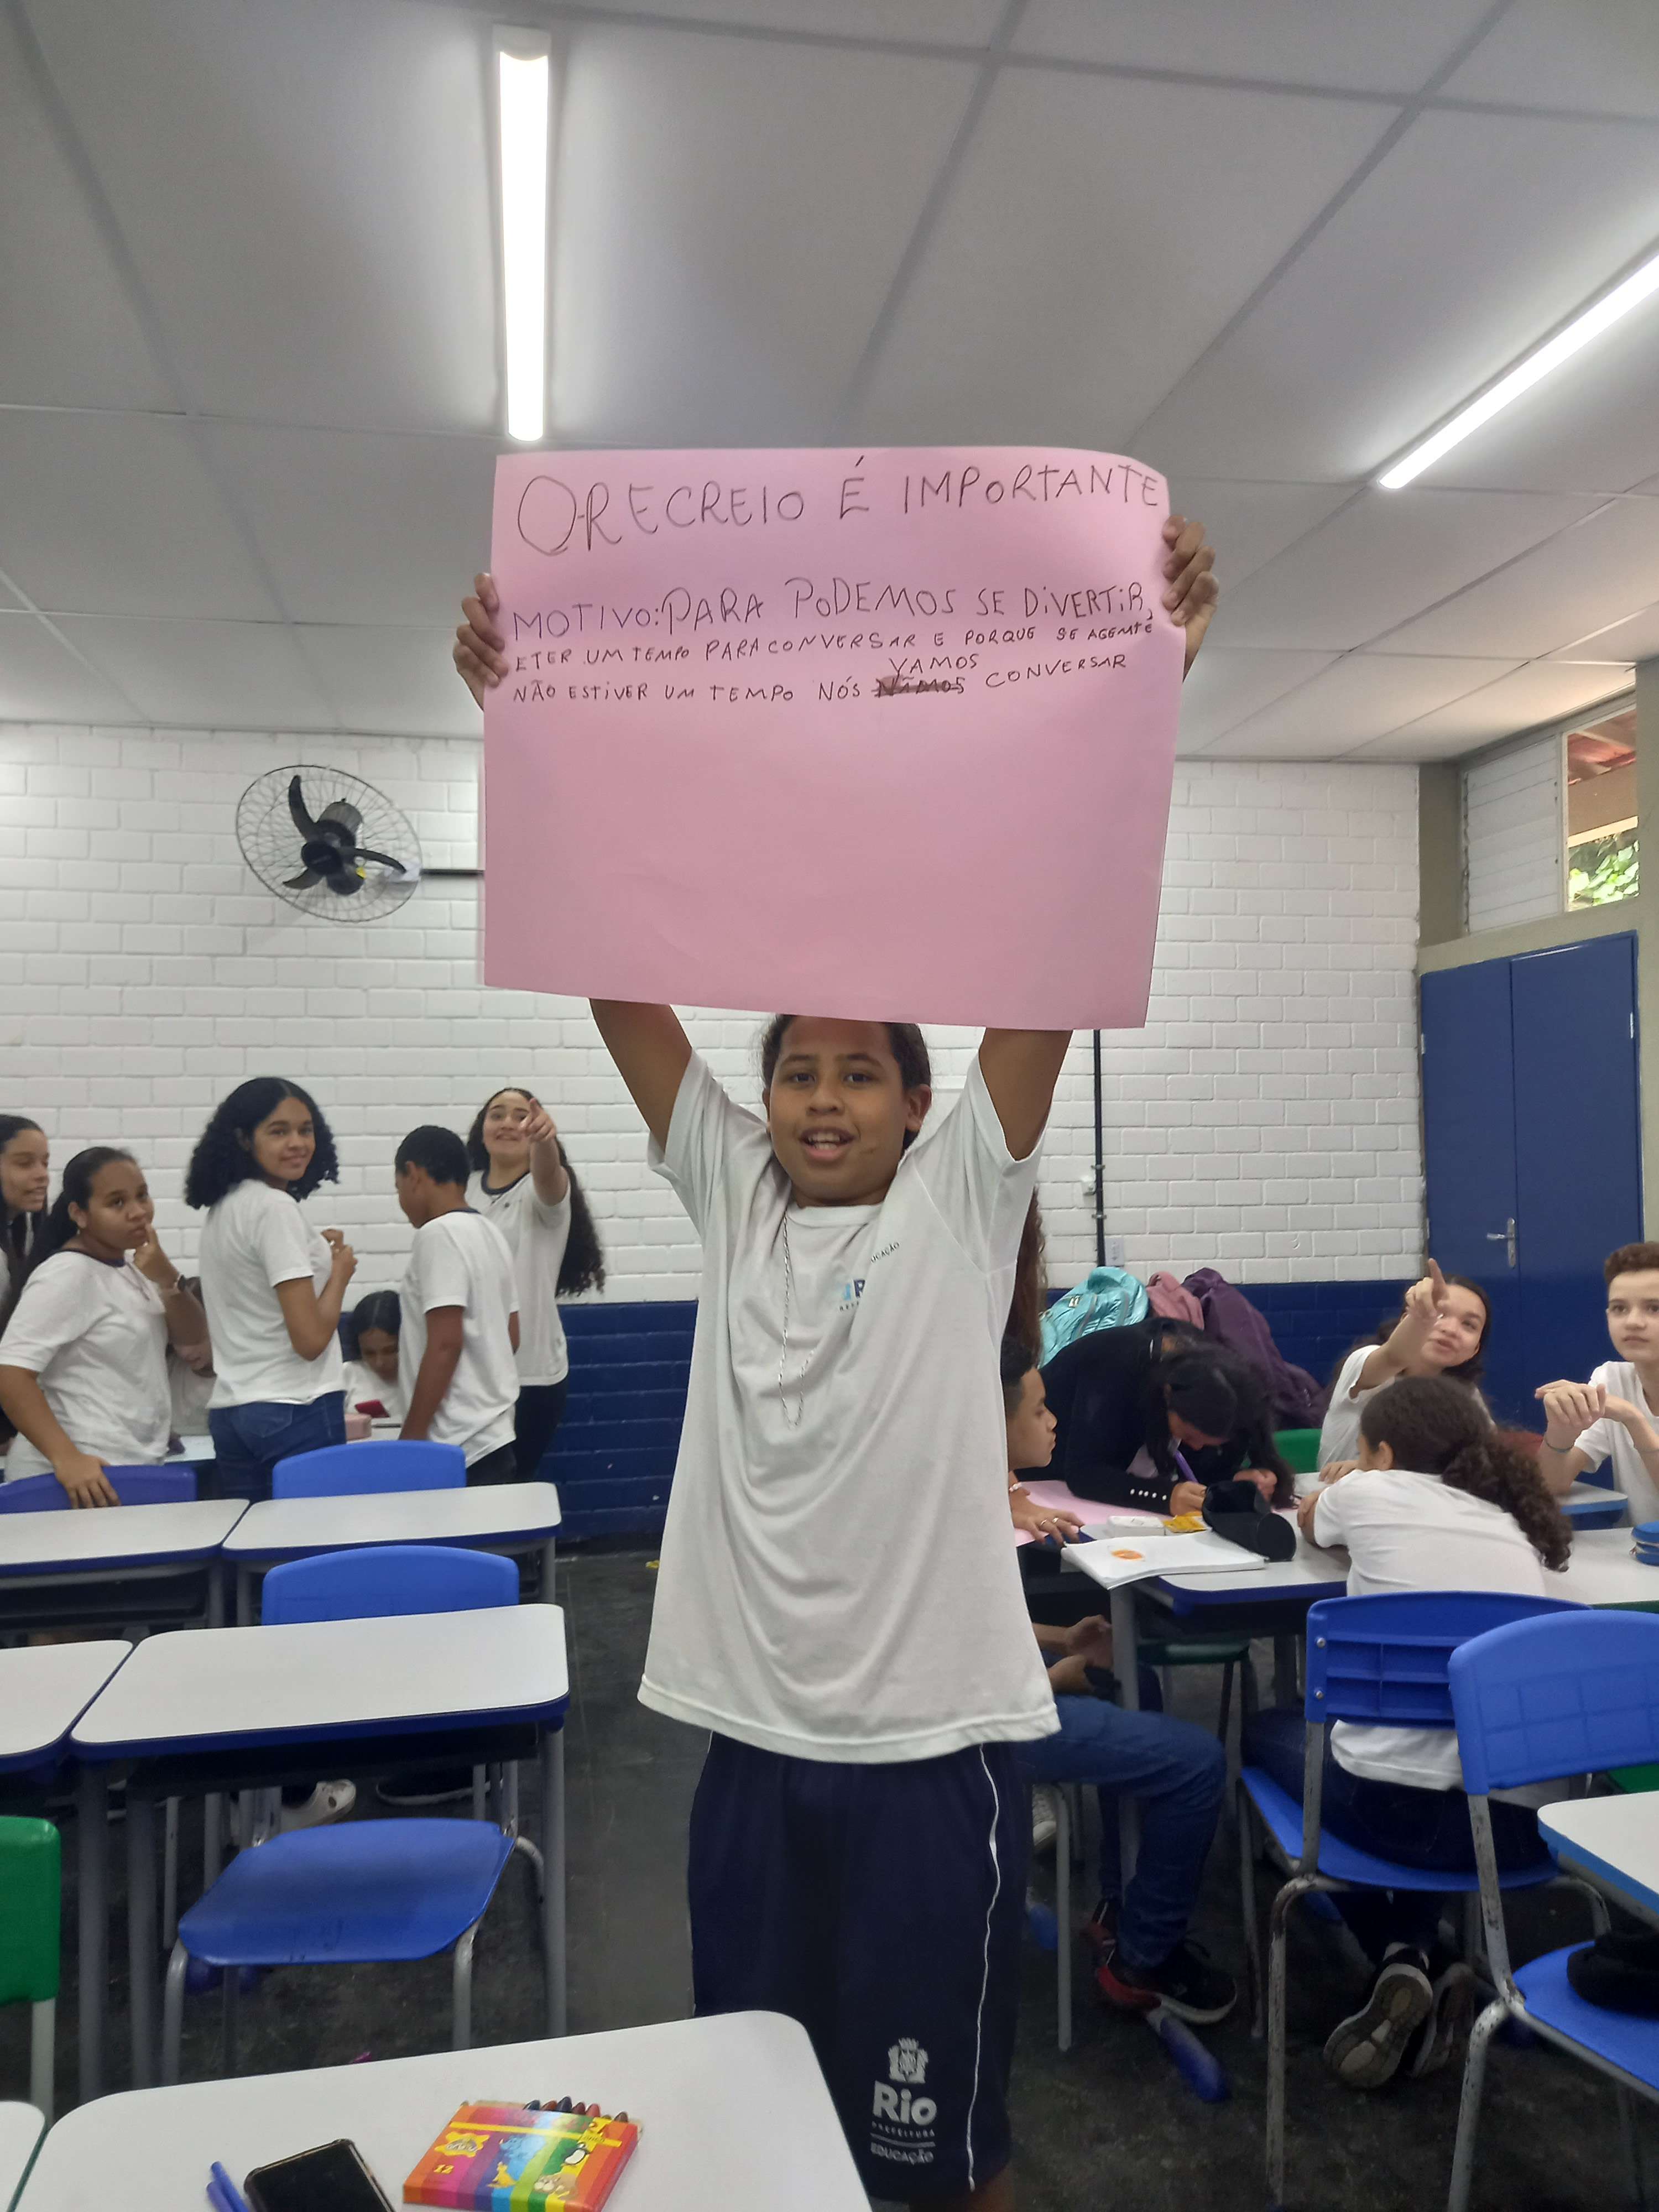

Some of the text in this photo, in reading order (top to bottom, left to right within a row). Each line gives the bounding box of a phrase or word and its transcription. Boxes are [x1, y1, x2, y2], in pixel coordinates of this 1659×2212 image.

[839, 455, 870, 520] É
[904, 465, 1158, 514] IMPORTANTE
[784, 577, 956, 619] PODEMOS
[976, 587, 1005, 617] SE
[586, 648, 624, 665] UM
[632, 645, 690, 663] TEMPO
[933, 632, 944, 648] E
[965, 625, 1036, 646] PORQUE
[1056, 627, 1079, 642] SE
[513, 679, 556, 703] NÃO
[665, 684, 695, 701] UM
[709, 684, 794, 703] TEMPO
[818, 675, 860, 702] NÓS
[985, 654, 1126, 688] CONVERSAR
[873, 2080, 937, 2126] Rio
